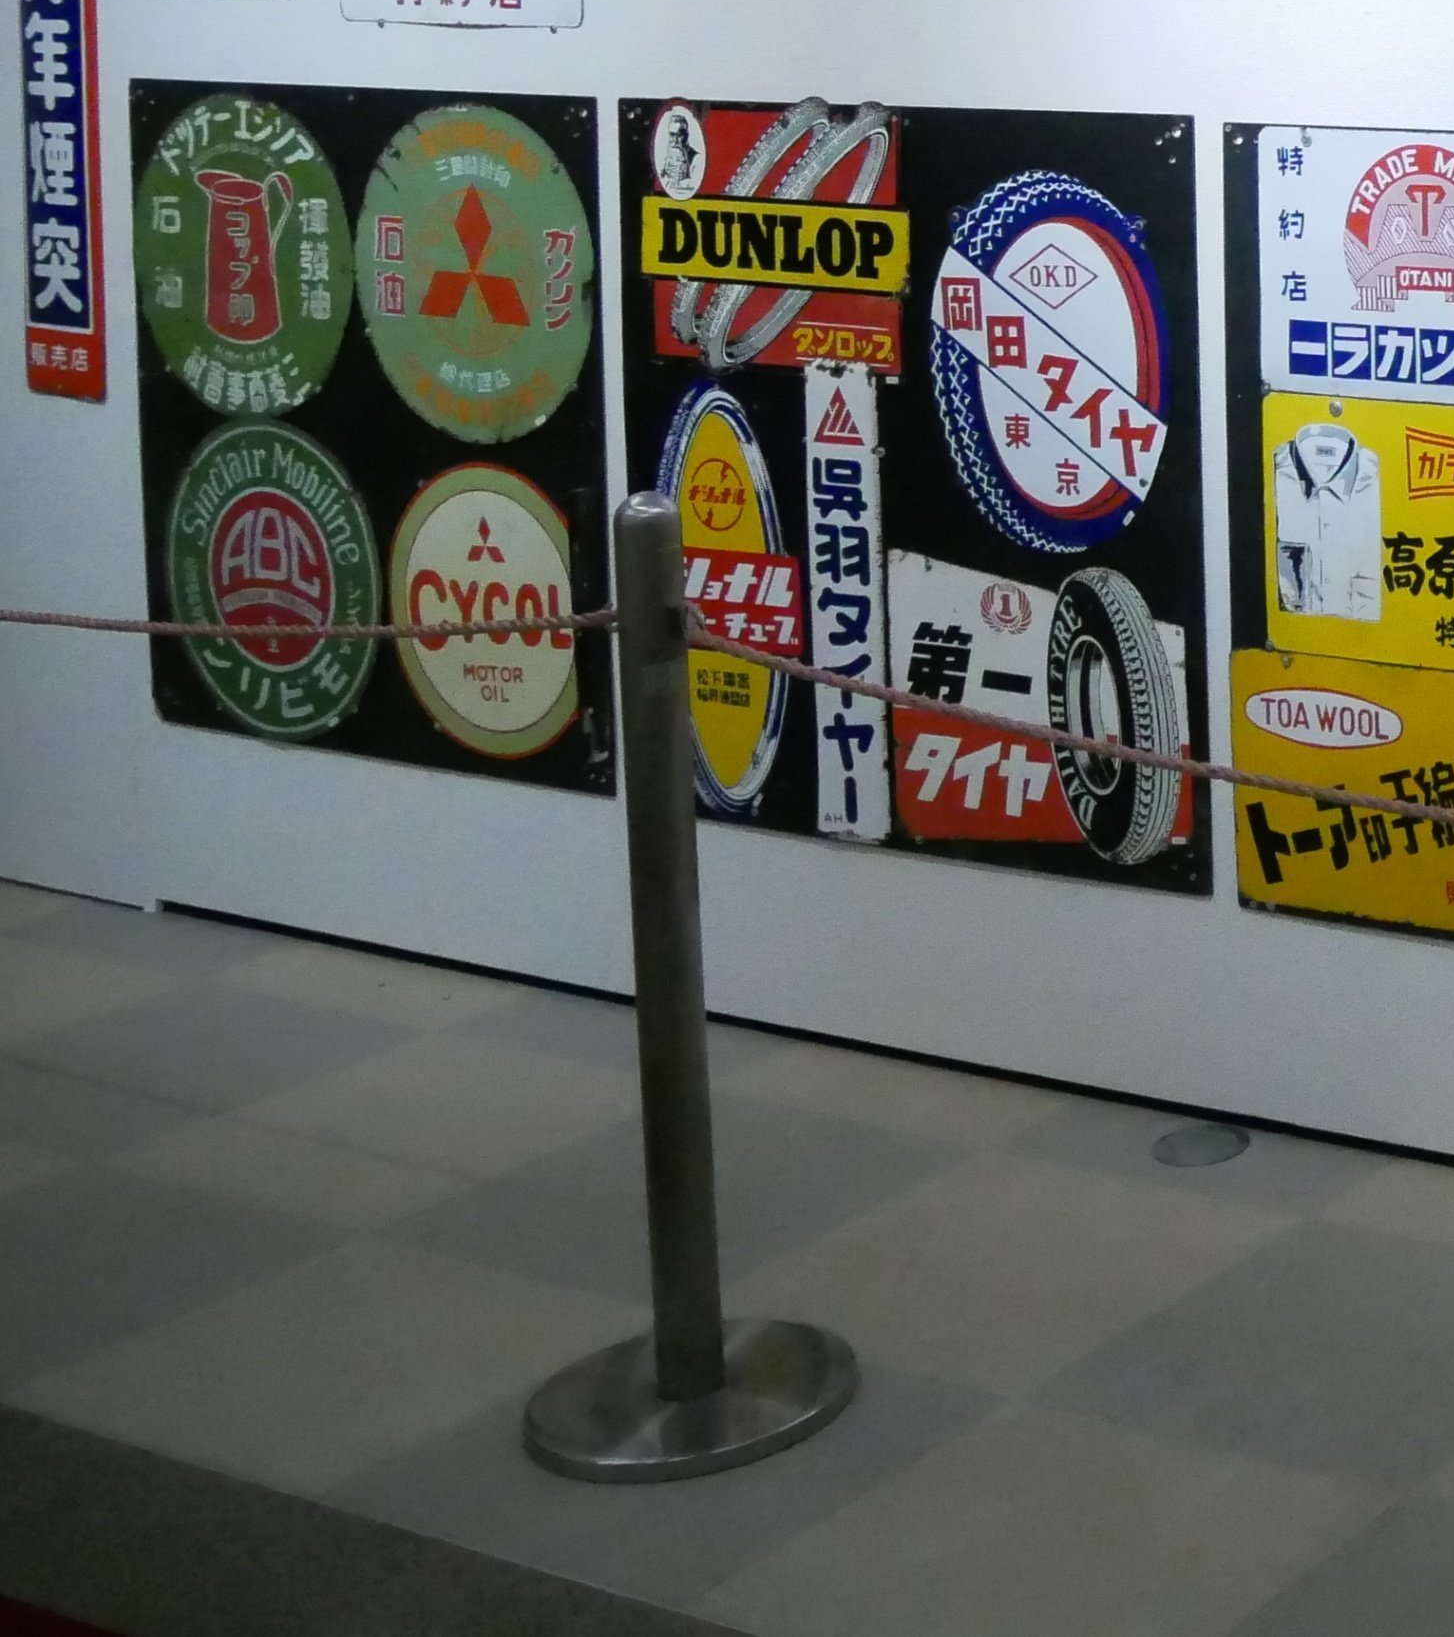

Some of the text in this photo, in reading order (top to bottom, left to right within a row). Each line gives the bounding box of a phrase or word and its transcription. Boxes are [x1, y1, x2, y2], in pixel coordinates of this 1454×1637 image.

[1350, 148, 1420, 217] TRADE
[657, 207, 895, 281] DUNLOP
[1275, 146, 1308, 302] 特約店
[375, 215, 406, 317] 石油
[543, 226, 576, 332] ガソリン
[1399, 268, 1453, 289] OTANI
[31, 342, 90, 373] 販売店
[793, 325, 895, 363] ダンロップ
[941, 276, 1158, 478] 岡田タイヤ
[1004, 413, 1081, 497] 東京
[182, 442, 359, 565] Sinclair Mobiline
[221, 507, 322, 601] ABC
[410, 569, 573, 651] CYCOL
[1049, 595, 1083, 681] TYRE
[463, 665, 524, 684] MOTOR
[480, 685, 510, 703] OIL
[908, 622, 1032, 704] 第一
[1260, 697, 1390, 741] TOA WOOL
[904, 733, 1053, 817] タイヤ
